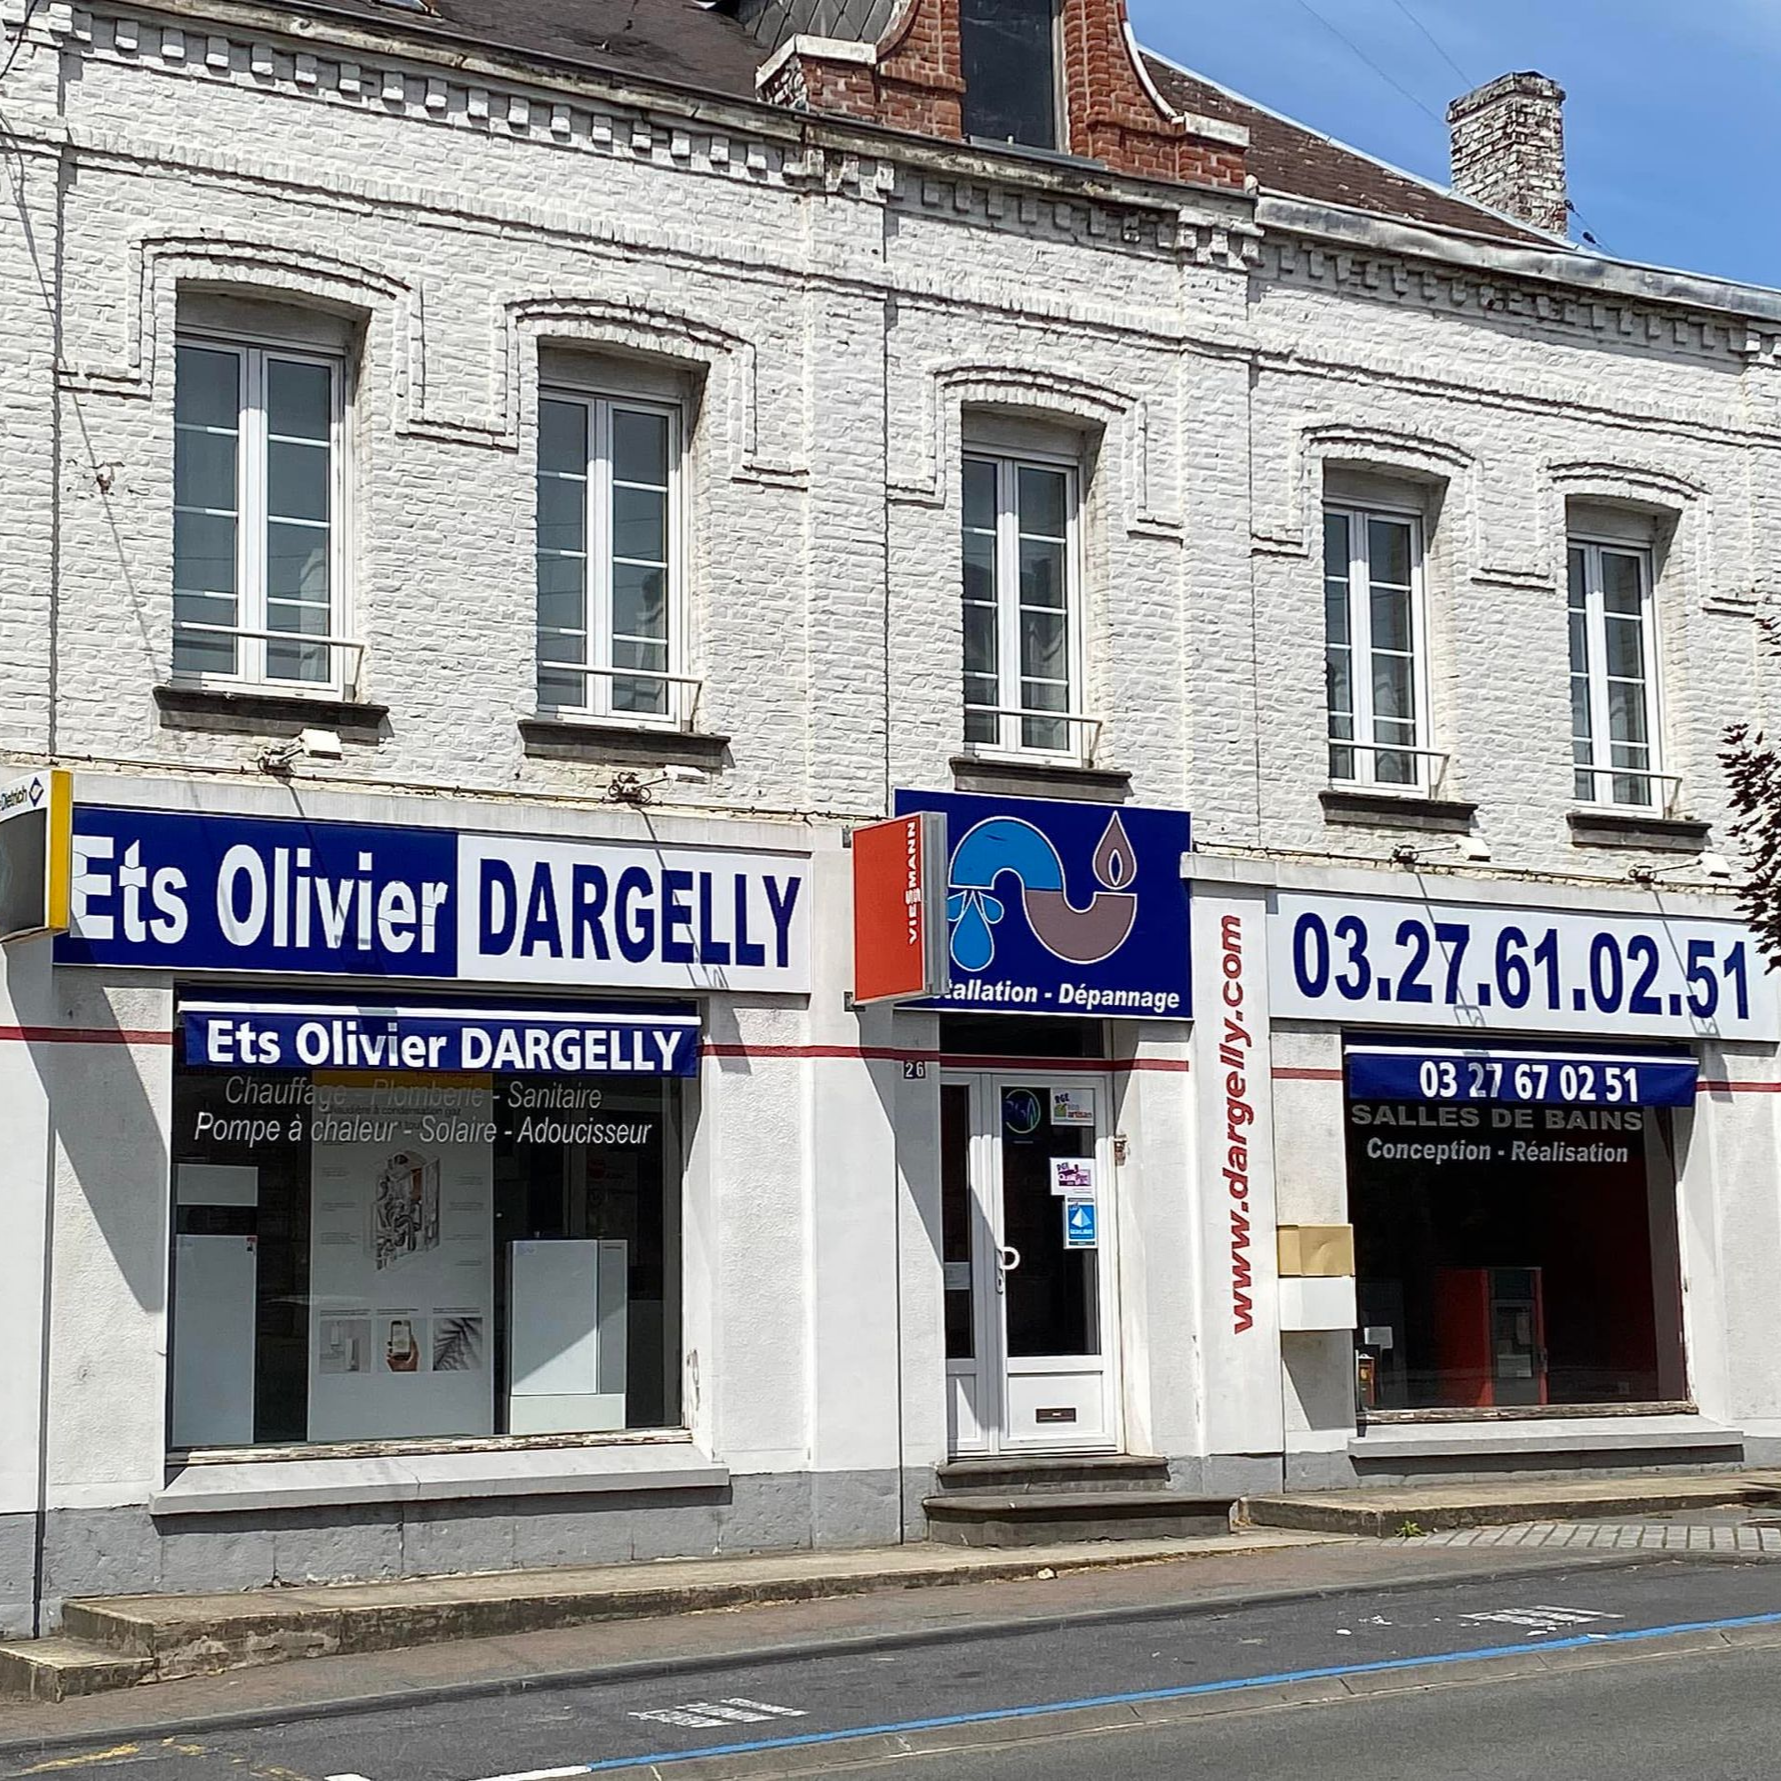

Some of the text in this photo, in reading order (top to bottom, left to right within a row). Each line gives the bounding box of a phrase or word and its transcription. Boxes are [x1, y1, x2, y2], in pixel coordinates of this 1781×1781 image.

[70, 834, 802, 968] Ets Olivier DARGELLY
[905, 821, 921, 945] VIESSMANN
[1292, 911, 1750, 1021] 03.27.61.02.51
[932, 978, 1038, 1003] tallation
[1058, 983, 1180, 1014] Dépannage
[207, 1019, 683, 1072] Ets Olivier DARGELLY
[905, 1061, 924, 1078] 26
[1420, 1060, 1638, 1103] 03 27 67 02 51
[225, 1075, 347, 1112] Chauffage
[371, 1078, 483, 1108] Plomberie
[508, 1080, 602, 1110] Sanitaire
[194, 1111, 281, 1149] Pompe
[288, 1113, 302, 1142] à
[311, 1114, 398, 1143] chaleur
[420, 1114, 497, 1144] Solaire
[517, 1115, 653, 1145] Adoucisseur
[1218, 914, 1254, 1335] www.dargelly.com
[1351, 1104, 1644, 1131] SALLES DE BAINS
[1366, 1136, 1492, 1165] Conception
[1511, 1139, 1629, 1163] Réalisation
